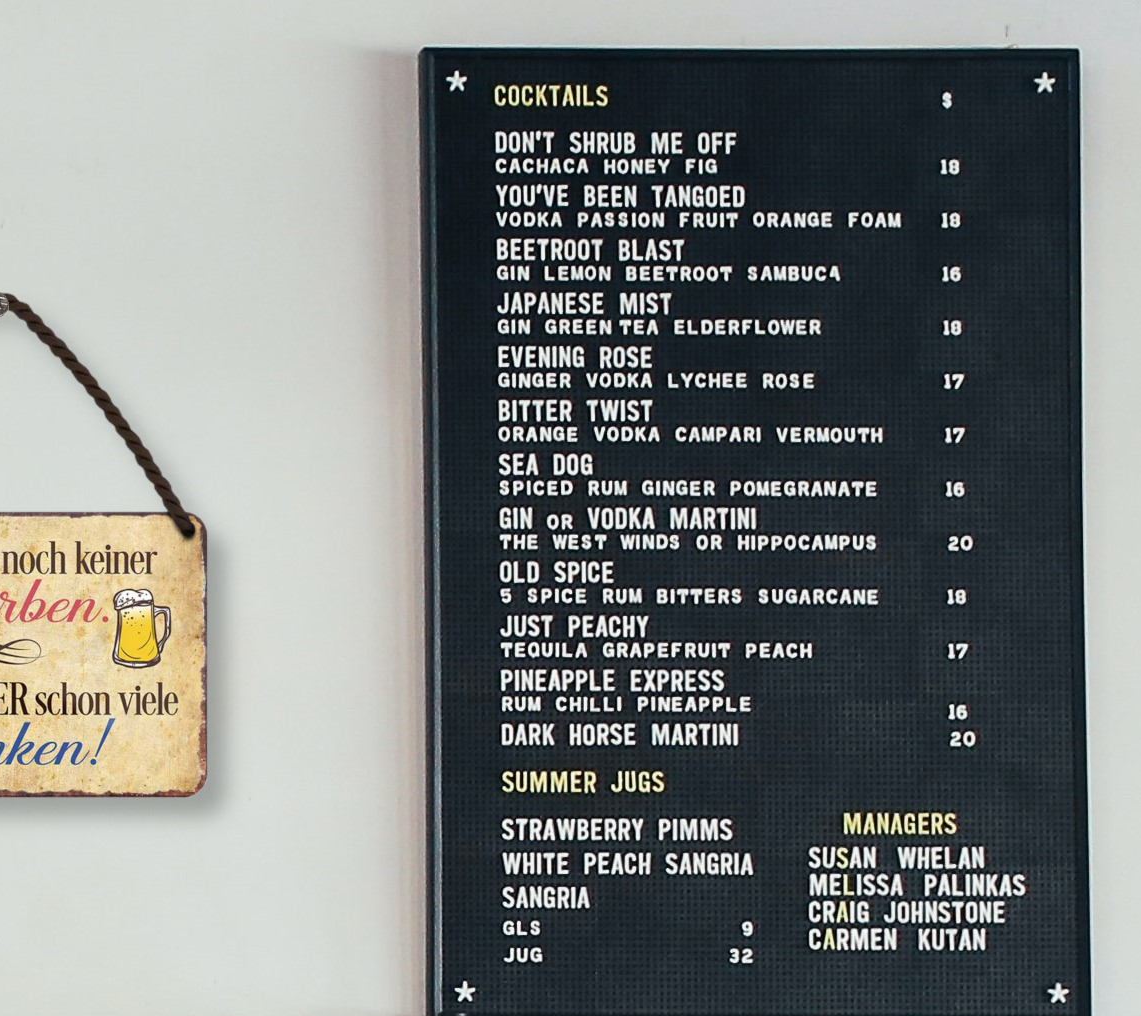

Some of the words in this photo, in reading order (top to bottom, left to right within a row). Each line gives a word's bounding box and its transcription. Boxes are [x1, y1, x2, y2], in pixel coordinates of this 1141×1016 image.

[494, 84, 609, 107] COCKTAILS
[494, 130, 555, 154] DON'T
[569, 131, 636, 155] SHRUB
[650, 131, 683, 155] ME
[697, 131, 737, 155] OFF
[495, 157, 589, 175] CACHACA
[603, 158, 671, 175] HONEY
[685, 158, 718, 175] FIG
[940, 158, 960, 176] 18
[495, 184, 569, 208] YOU'VE
[583, 184, 637, 208] BEEN
[650, 184, 746, 209] TANGOED
[495, 211, 563, 228] VODKA
[577, 211, 665, 228] PASSION
[679, 211, 739, 229] FRUIT
[752, 211, 833, 229] ORANGE
[848, 211, 902, 229] FOAM
[941, 212, 961, 229] 18
[496, 238, 604, 262] BEETROOT
[618, 238, 685, 262] BLAST
[496, 265, 530, 282] GIN
[544, 265, 612, 282] LEMON
[625, 265, 733, 282] BEETROOT
[941, 266, 962, 283] 16
[496, 291, 604, 315] JAPANESE
[619, 292, 672, 316] MIST
[497, 318, 531, 335] GIN
[544, 318, 613, 336] GREEN
[618, 319, 659, 336] TEA
[673, 318, 822, 336] ELDERFLOWER
[942, 319, 962, 336] 18
[497, 345, 585, 369] EVENING
[599, 345, 653, 370] ROSE
[497, 372, 572, 389] GINGER
[585, 372, 653, 389] VODKA
[667, 372, 748, 389] LYCHEE
[762, 372, 815, 390] ROSE
[943, 373, 965, 390] 17
[498, 399, 573, 423] BITTER
[585, 399, 653, 423] TWIST
[497, 425, 578, 443] ORANGE
[593, 425, 661, 443] VODKA
[674, 426, 762, 443] CAMPARI
[776, 426, 884, 444] VERMOUTH
[944, 427, 966, 444] 17
[498, 453, 539, 476] SEA
[552, 453, 594, 476] DOG
[499, 479, 574, 497] SPICED
[587, 480, 628, 497] RUM
[641, 479, 716, 497] GINGER
[729, 480, 878, 498] POMEGRANATE
[945, 481, 965, 498] 16
[499, 506, 533, 530] GIN
[546, 513, 574, 531] OR
[587, 506, 656, 530] VODKA
[669, 506, 757, 531] MARTINI
[499, 533, 539, 550] THE
[552, 533, 608, 551] WEST
[619, 533, 680, 550] WINDS
[695, 534, 723, 551] OR
[737, 534, 877, 552] HIPPOCAMPUS
[947, 535, 974, 552] 20
[2, 541, 66, 575] noch
[75, 541, 158, 575] keiner
[499, 560, 540, 584] OLD
[553, 560, 615, 584] SPICE
[499, 587, 512, 604] 5
[527, 587, 587, 605] SPICE
[602, 587, 643, 605] RUM
[656, 587, 742, 605] BITTERS
[758, 588, 879, 606] SUGARCANE
[947, 588, 967, 605] 18
[499, 614, 554, 638] JUST
[567, 614, 649, 638] PEACHY
[500, 641, 588, 659] TEQUILA
[602, 641, 731, 659] GRAPEFRUIT
[745, 642, 813, 659] PEACH
[947, 643, 969, 660] 17
[500, 668, 616, 693] PINEAPPLE
[630, 669, 725, 693] EXPRESS
[34, 681, 112, 716] schon
[117, 681, 179, 716] viele
[501, 695, 542, 712] RUM
[555, 696, 623, 713] CHILLI
[637, 695, 752, 713] PINEAPPLE
[947, 703, 968, 721] 16
[501, 723, 555, 747] DARK
[569, 722, 637, 747] HORSE
[651, 722, 739, 747] MARTINI
[949, 730, 977, 748] 20
[501, 770, 597, 794] SUMMER
[610, 770, 665, 793] JUGS
[501, 817, 644, 842] STRAWBERRY
[658, 818, 734, 842] PIMMS
[843, 812, 958, 836] MANAGERS
[502, 851, 570, 876] WHITE
[583, 851, 652, 876] PEACH
[665, 852, 754, 876] SANGRIA
[808, 845, 877, 870] SUSAN
[897, 846, 985, 870] WHELAN
[809, 873, 904, 897] MELISSA
[924, 873, 1027, 897] PALINKAS
[502, 885, 591, 910] SANGRIA
[808, 900, 870, 924] CRAIG
[883, 900, 1006, 924] JOHNSTONE
[502, 920, 541, 936] GLS
[741, 920, 754, 937] 9
[808, 927, 898, 951] CARMEN
[917, 927, 987, 952] KUTAN
[503, 946, 543, 963] JUG
[729, 947, 754, 964] 32
